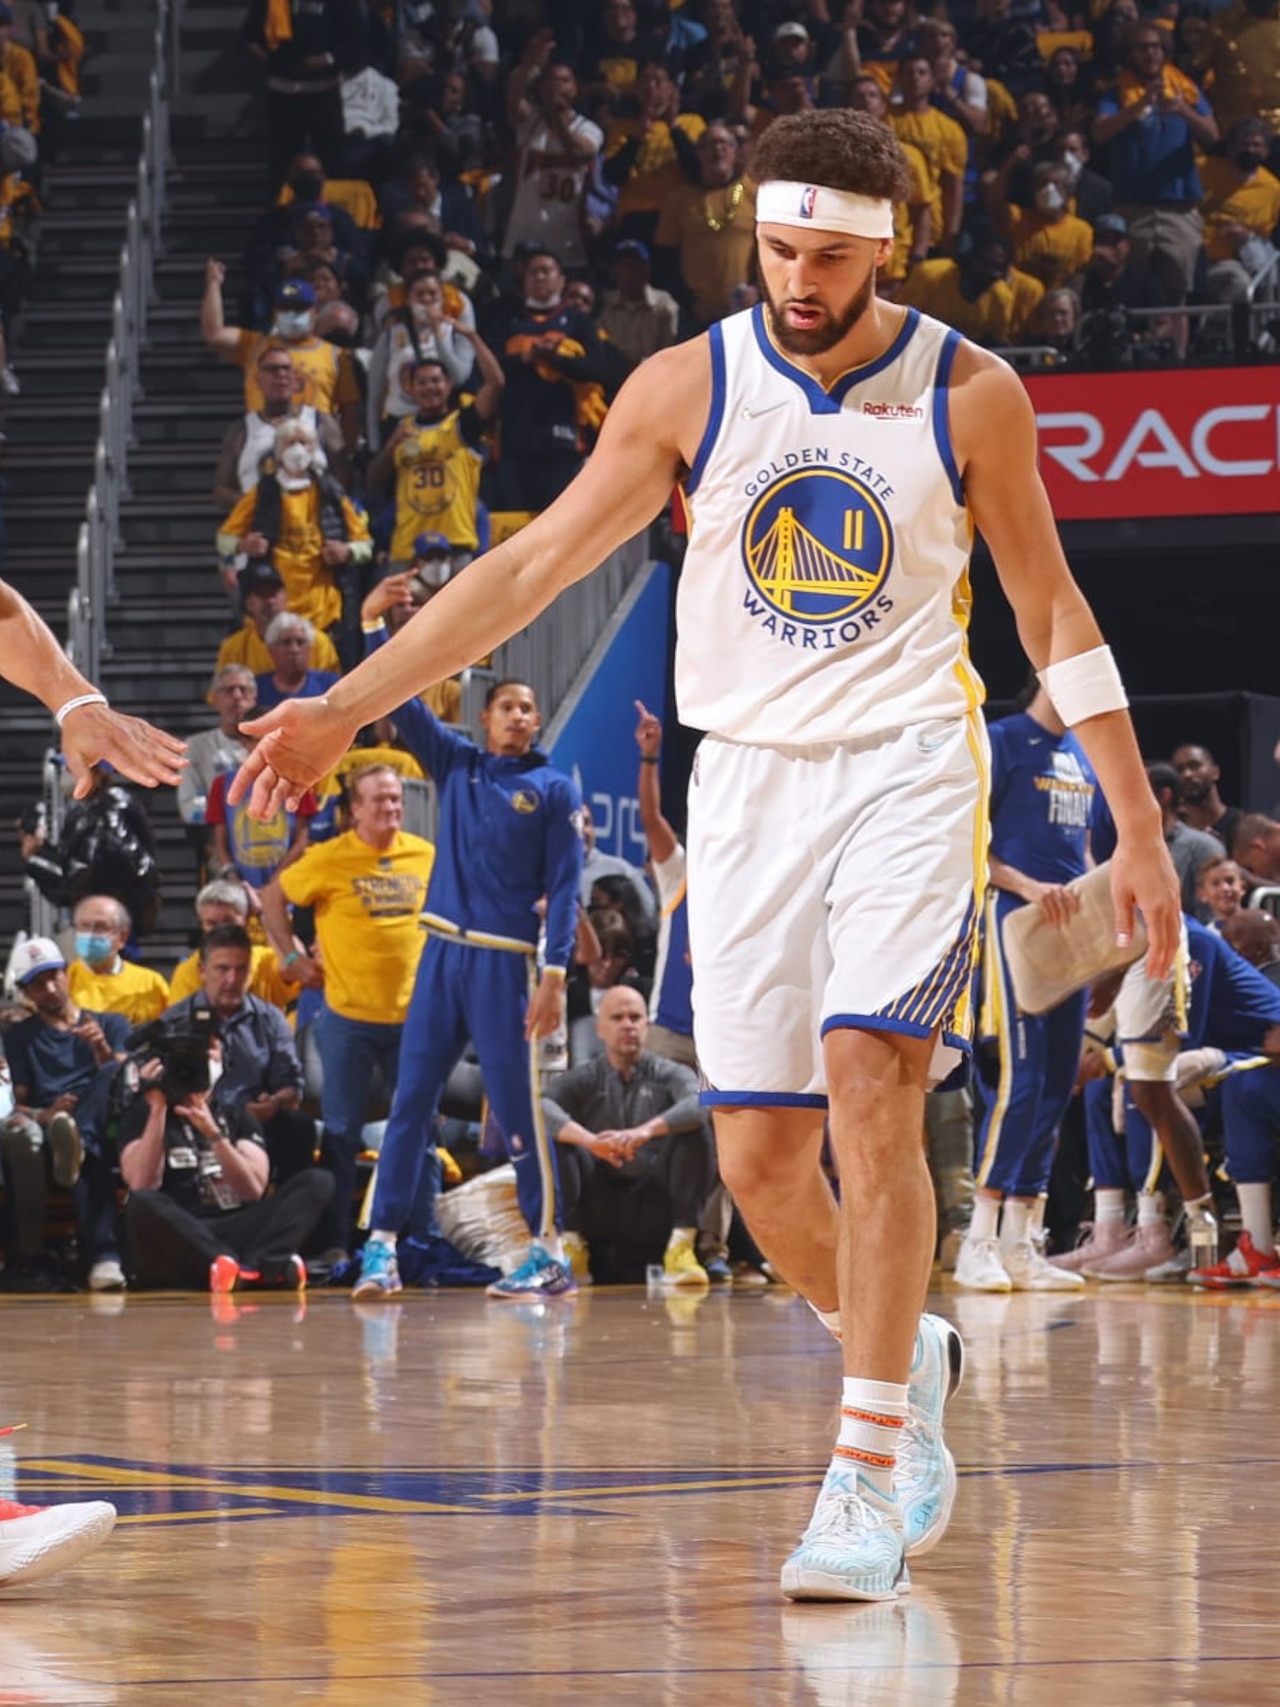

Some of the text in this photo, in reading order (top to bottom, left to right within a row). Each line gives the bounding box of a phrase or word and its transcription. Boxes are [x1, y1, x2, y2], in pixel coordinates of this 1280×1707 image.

[863, 402, 923, 420] Rakuten
[1036, 404, 1280, 482] RAC
[745, 448, 894, 501] GOLDEN STATE
[843, 509, 864, 550] 11
[743, 588, 894, 649] WARRIORS
